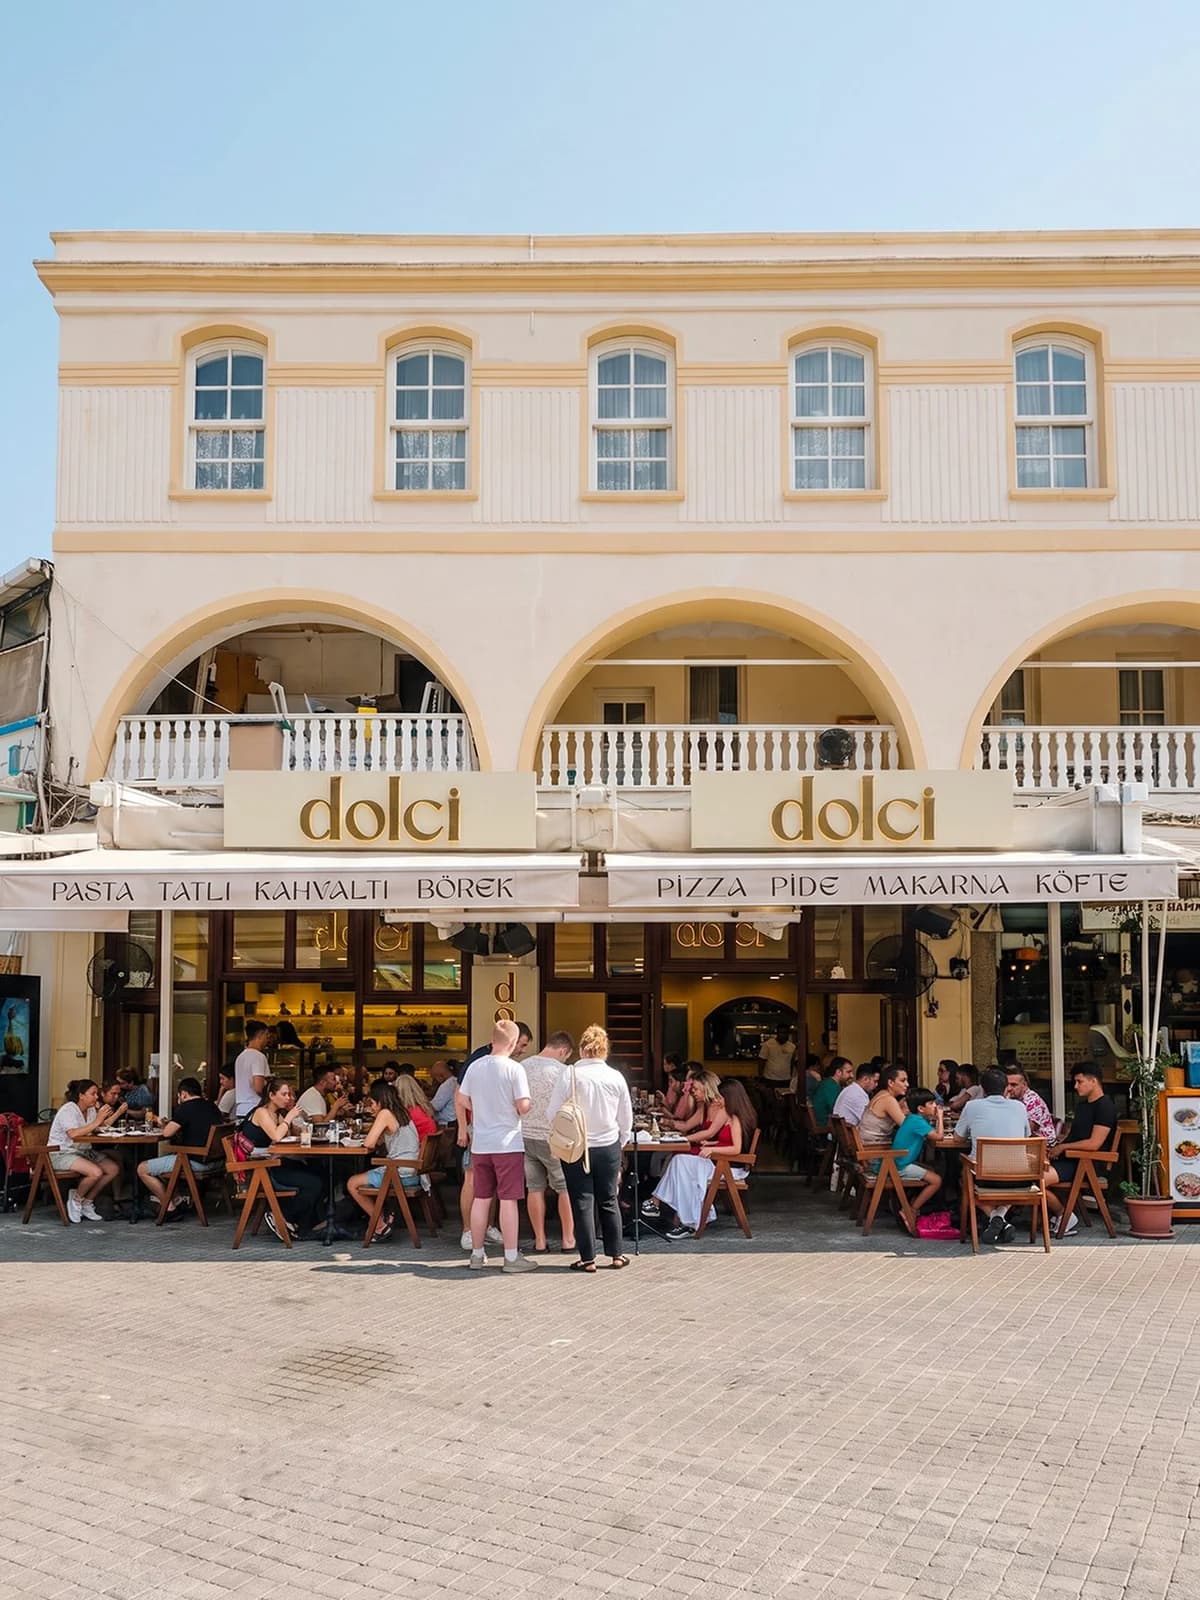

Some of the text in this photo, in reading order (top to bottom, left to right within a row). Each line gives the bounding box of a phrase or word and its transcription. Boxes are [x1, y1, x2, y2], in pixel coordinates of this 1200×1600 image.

[299, 776, 460, 841] dolci
[771, 775, 936, 841] dolci
[52, 874, 513, 901] PASTA TATLI KAHVALTI BÖREK
[657, 871, 1129, 898] PİZZA PİDE MAKARNA KÖFTE
